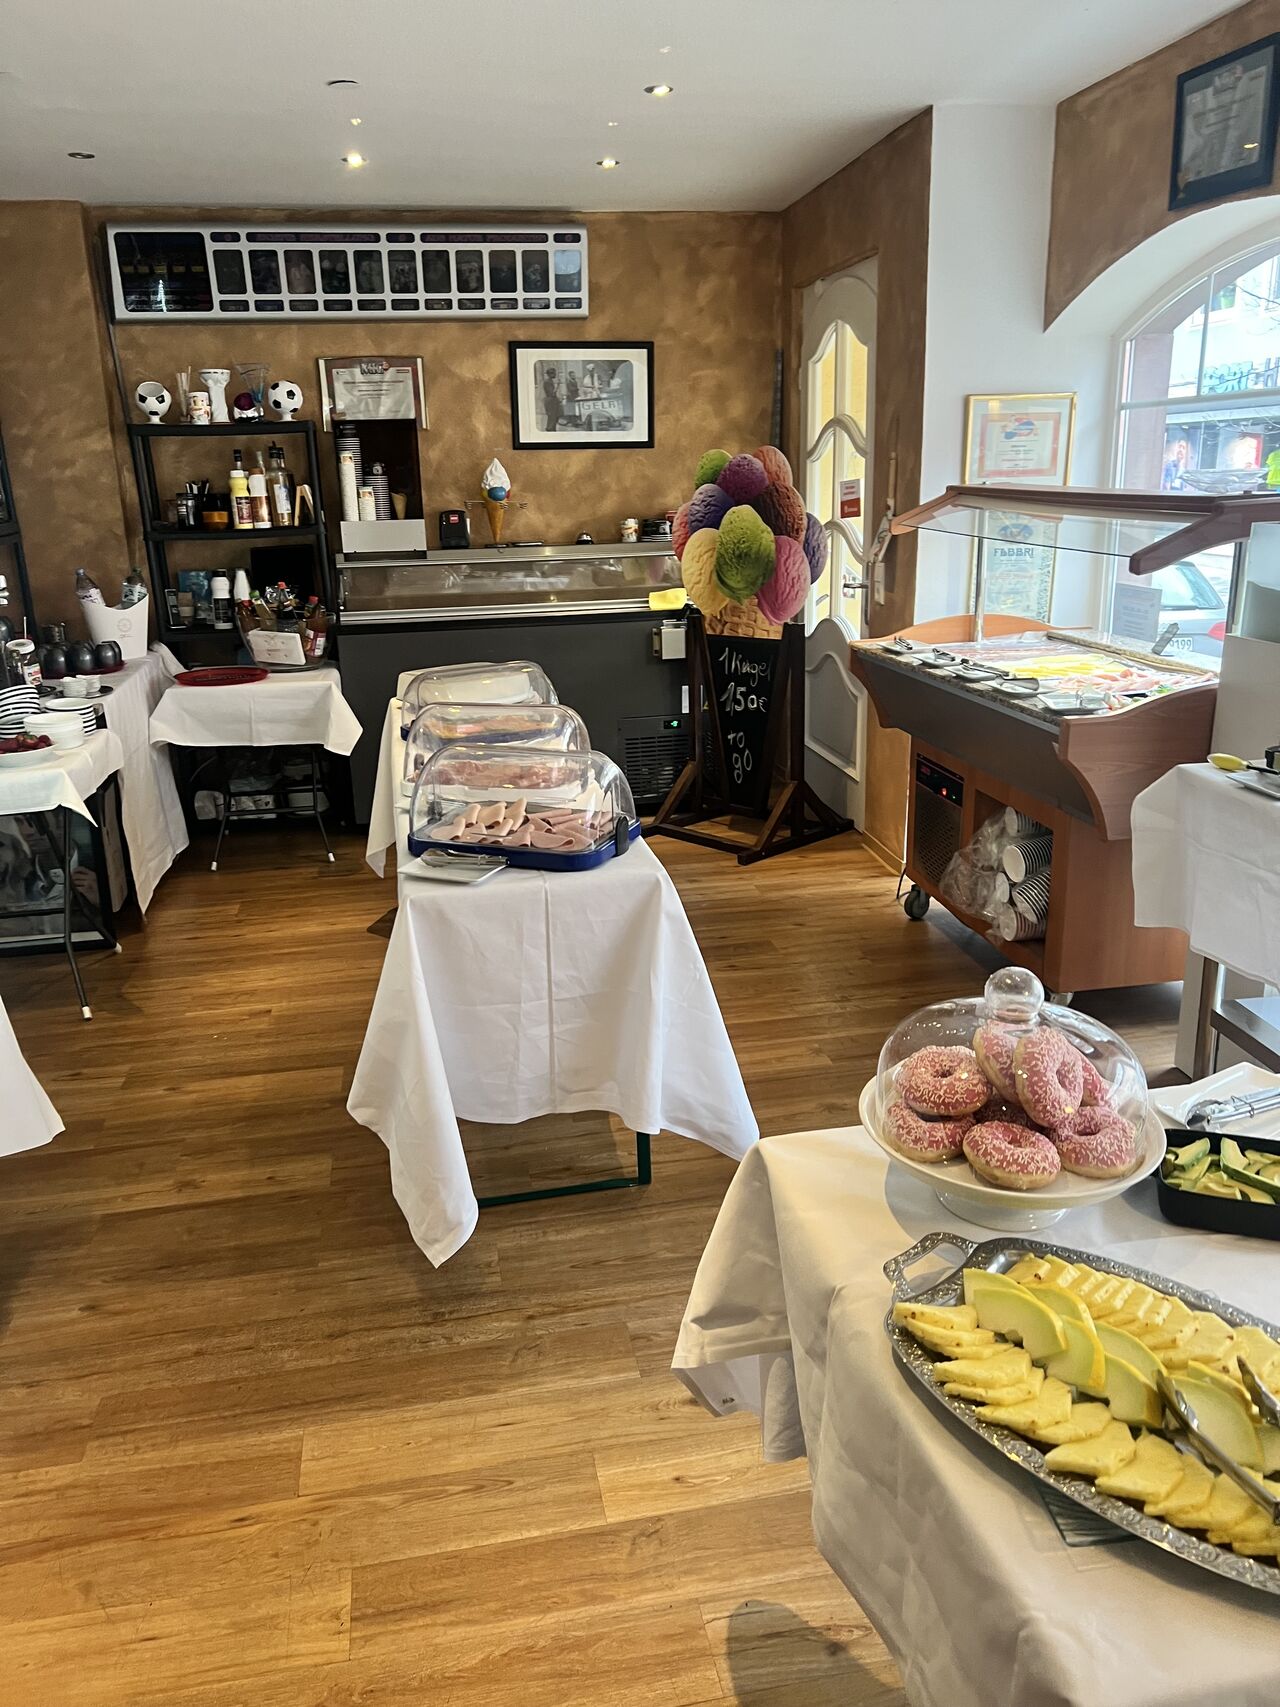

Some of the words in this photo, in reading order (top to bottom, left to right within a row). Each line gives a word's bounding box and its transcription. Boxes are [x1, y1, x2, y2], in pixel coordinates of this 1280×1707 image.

[718, 647, 729, 675] 1
[731, 651, 772, 687] Kugel
[727, 730, 745, 748] to
[732, 748, 752, 784] go
